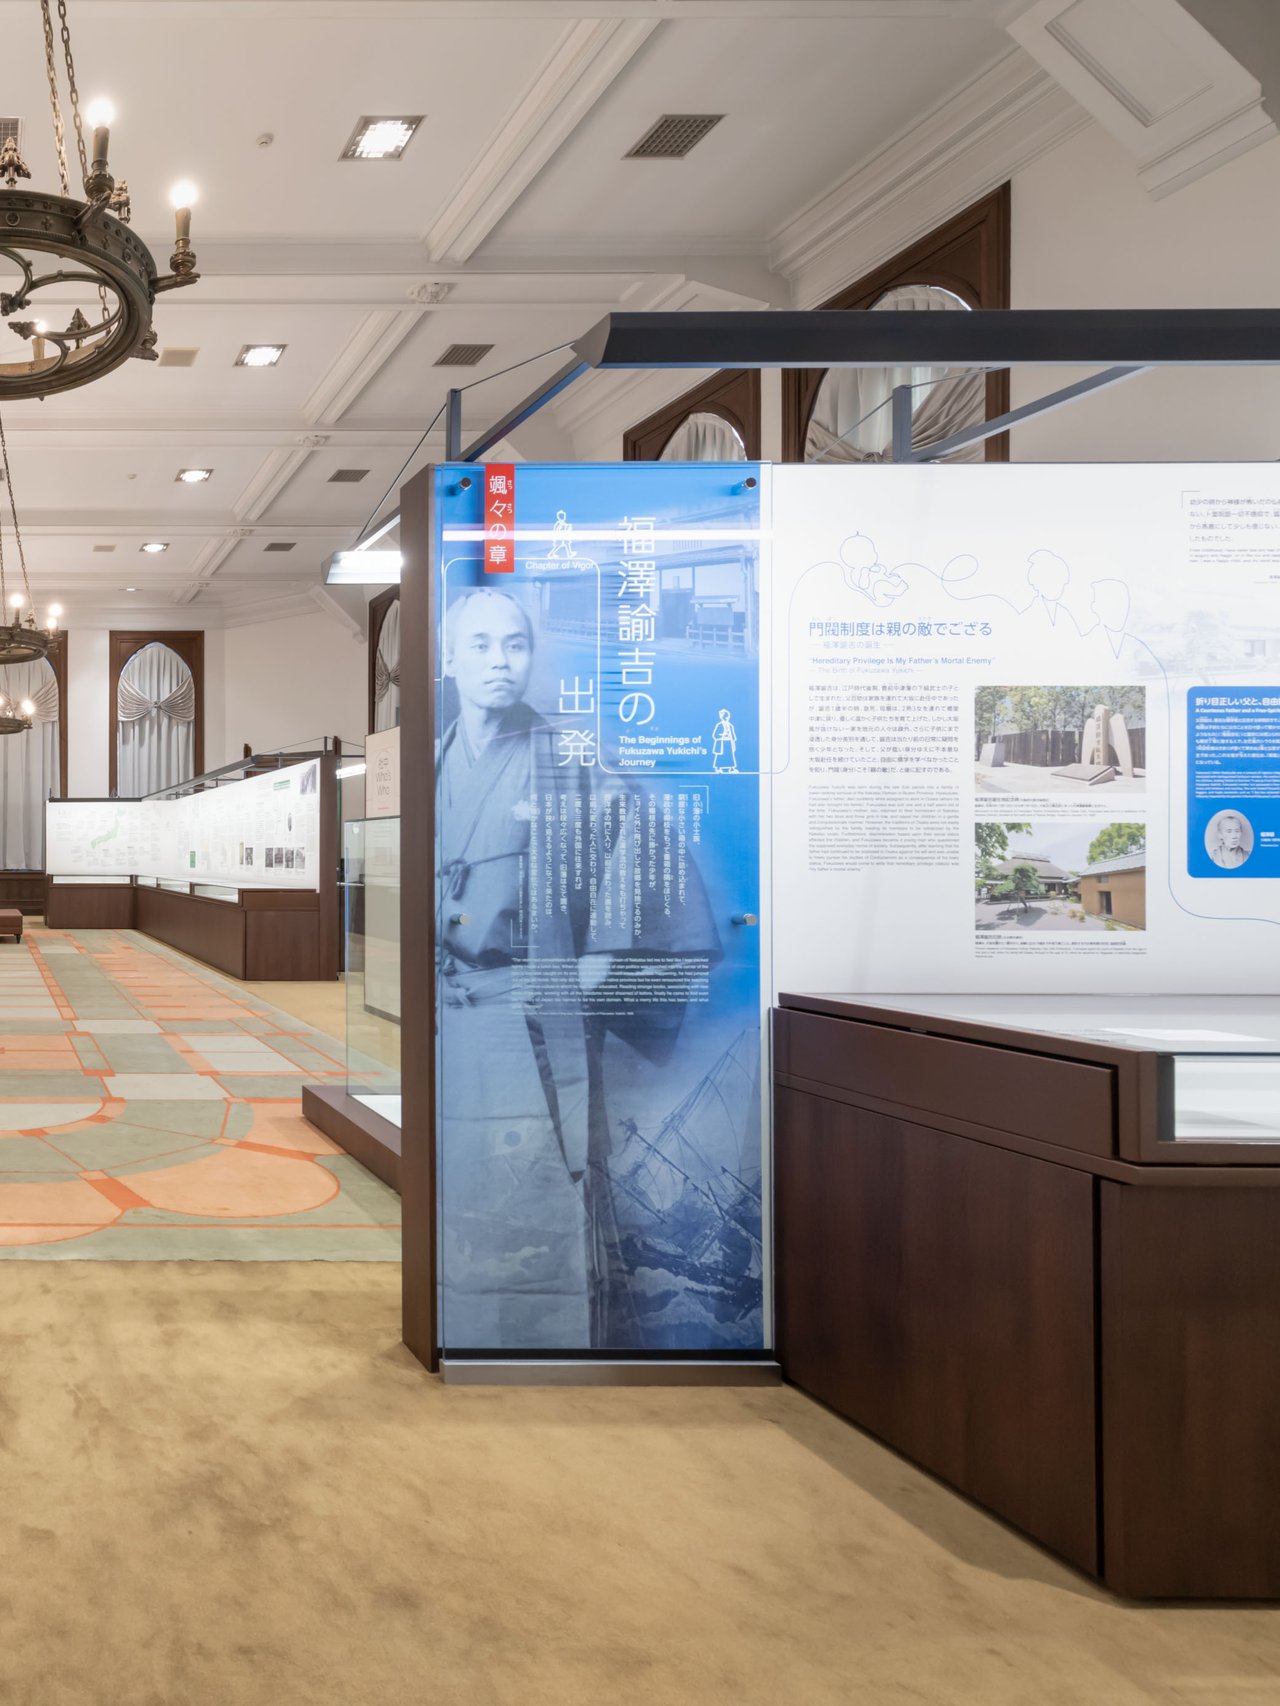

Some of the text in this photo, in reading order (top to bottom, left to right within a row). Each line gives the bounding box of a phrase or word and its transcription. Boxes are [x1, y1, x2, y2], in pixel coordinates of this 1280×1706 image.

[489, 475, 508, 565] 颯々の章
[525, 561, 594, 571] Chapter of Vigor
[617, 516, 657, 726] 福澤諭吉の
[809, 622, 993, 637] 門閥制度は親の敵でござる
[852, 656, 886, 666] Privilege
[886, 656, 893, 664] Is
[896, 656, 907, 666] My
[941, 656, 965, 664] Mortal
[557, 675, 595, 767] 出発
[619, 736, 702, 747] The Beginnings of
[619, 746, 707, 756] Fukuzawa Yukichi's
[618, 758, 656, 768] Journey
[376, 785, 390, 796] Who
